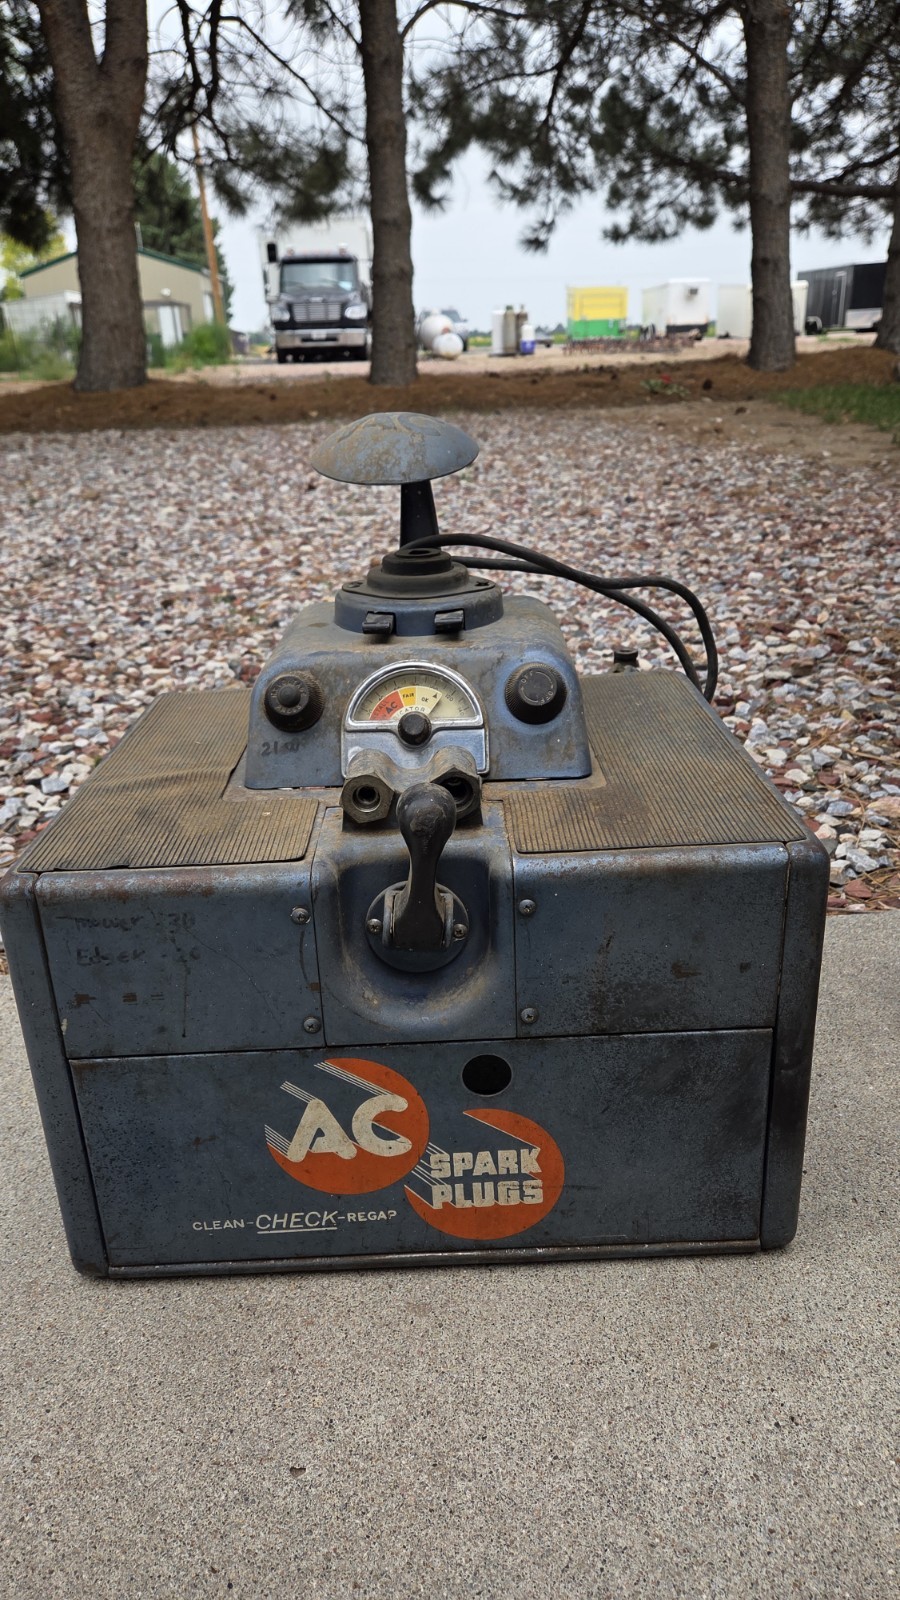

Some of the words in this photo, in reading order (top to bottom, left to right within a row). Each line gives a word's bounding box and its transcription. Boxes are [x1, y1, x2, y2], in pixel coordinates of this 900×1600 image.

[385, 702, 398, 715] AC
[286, 1094, 413, 1163] AC
[430, 1148, 542, 1179] SPARK
[431, 1179, 544, 1210] PLUGS
